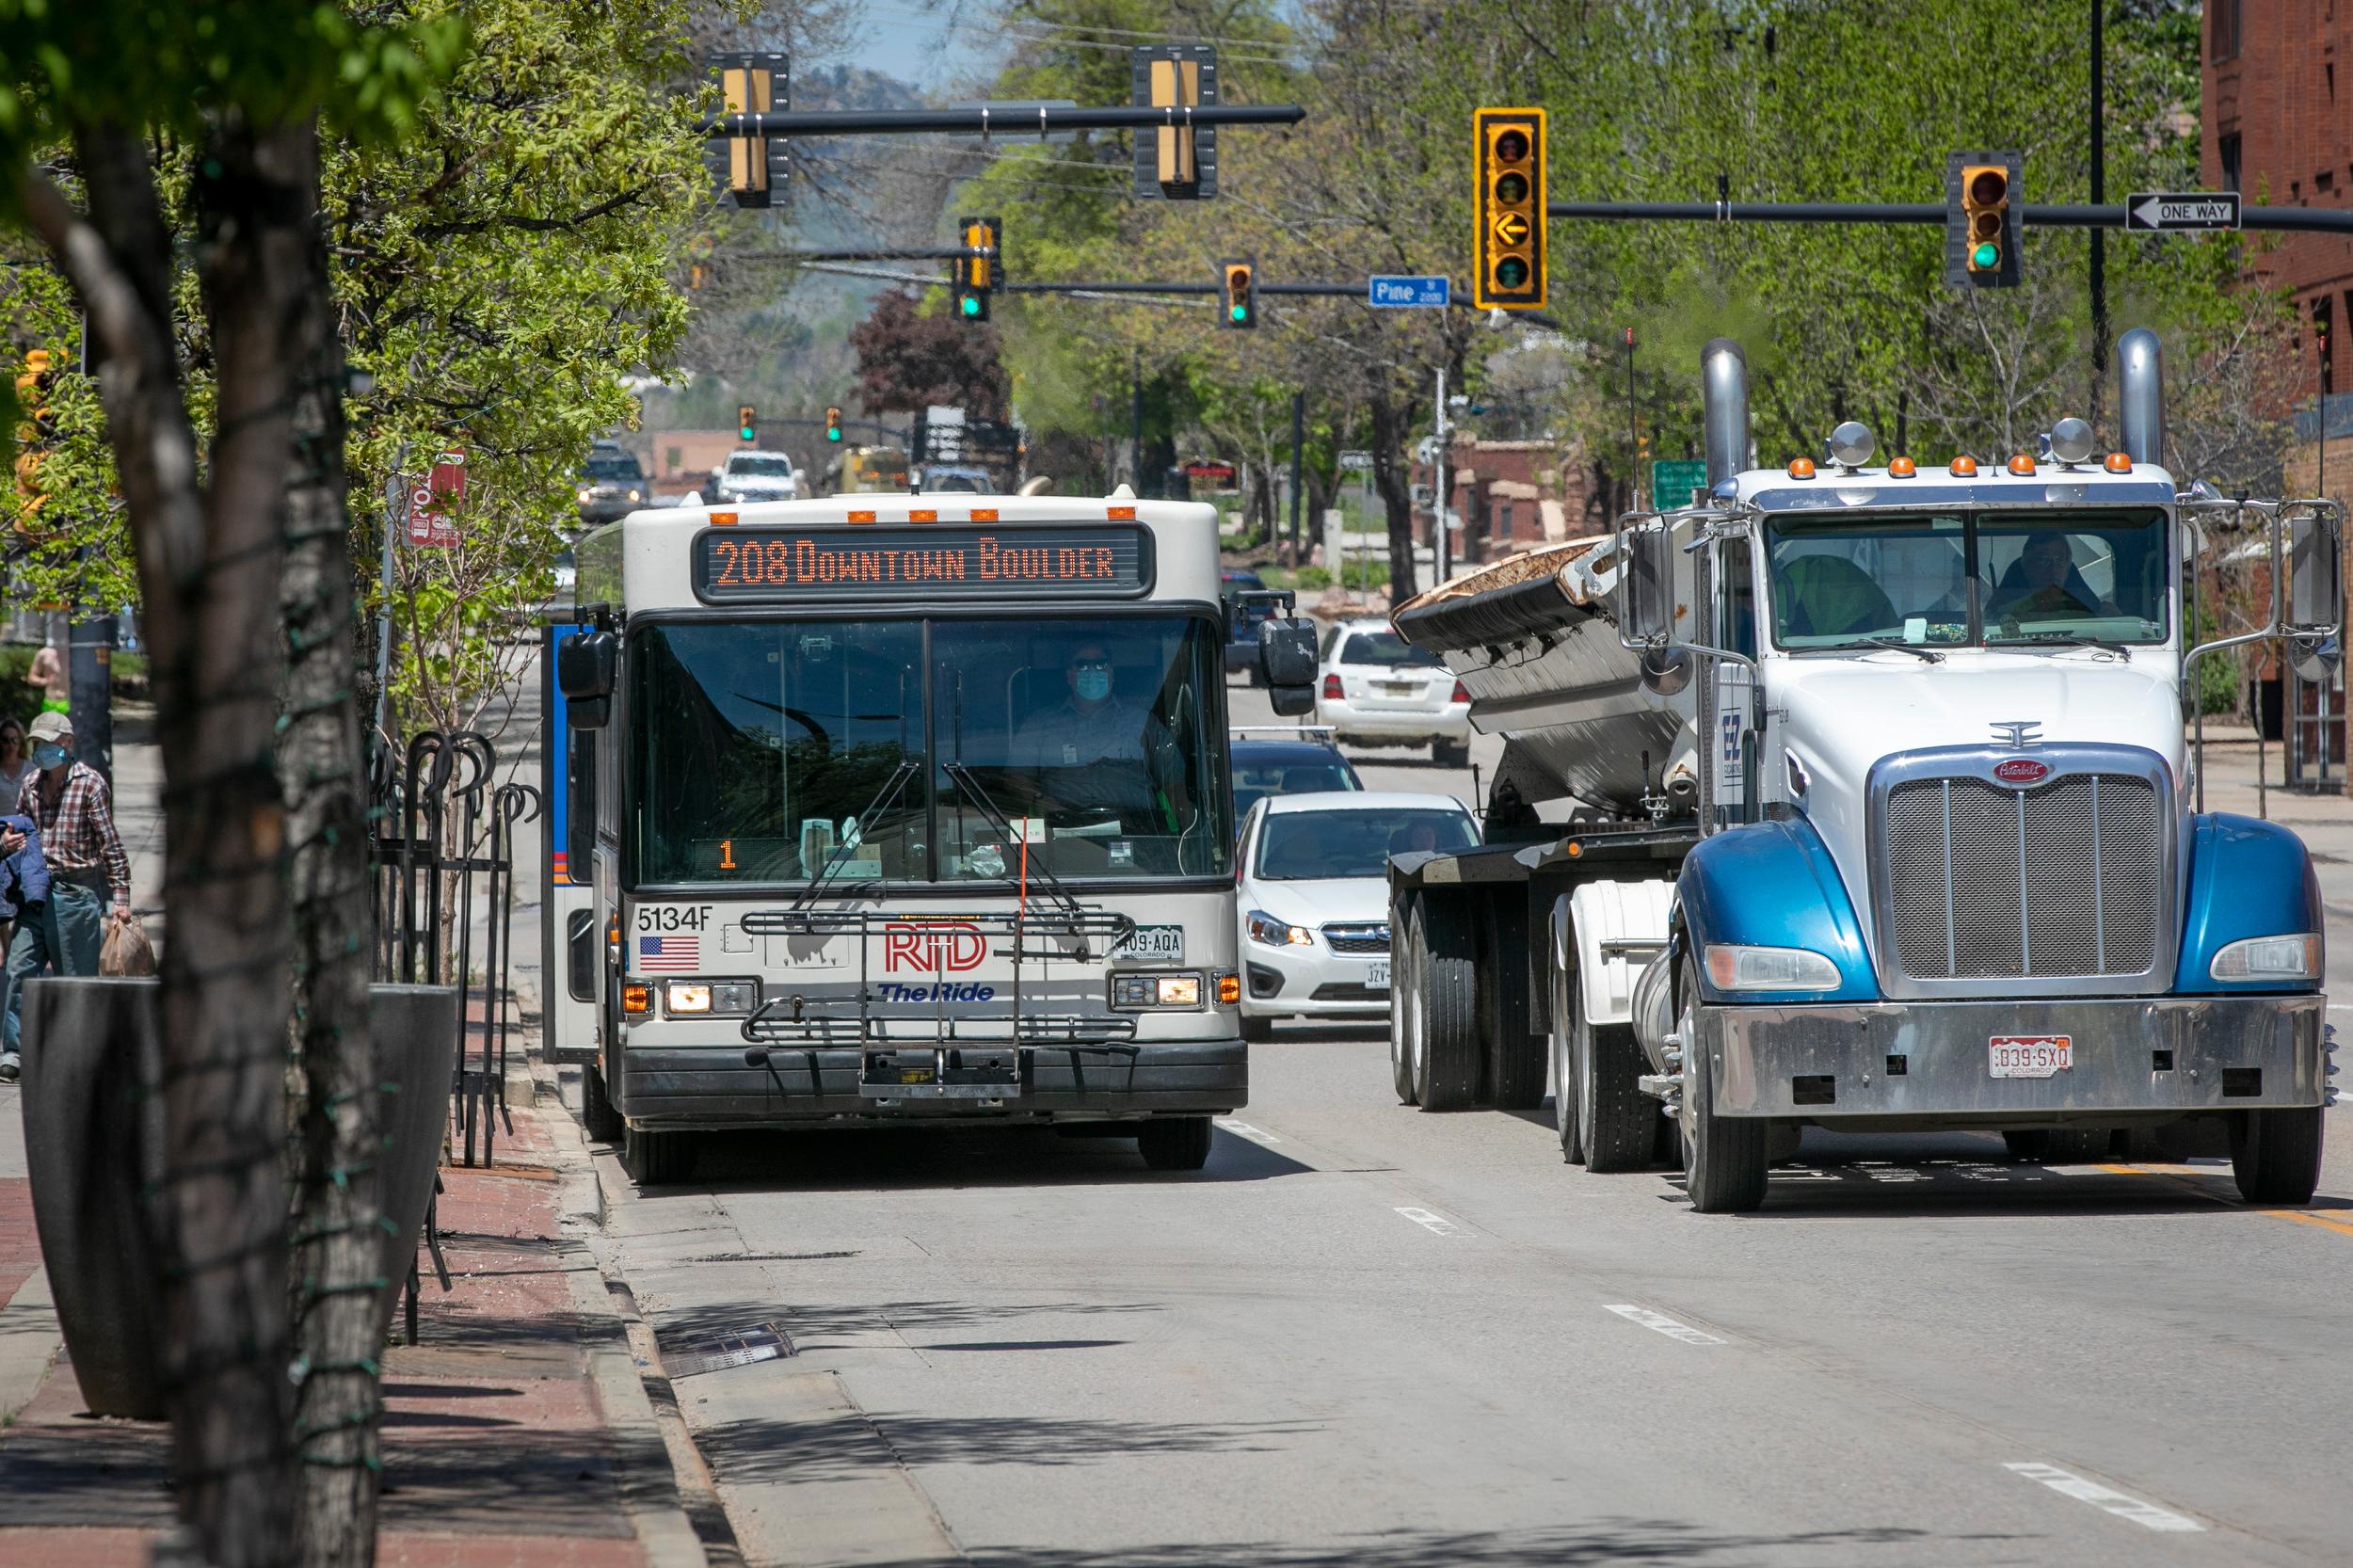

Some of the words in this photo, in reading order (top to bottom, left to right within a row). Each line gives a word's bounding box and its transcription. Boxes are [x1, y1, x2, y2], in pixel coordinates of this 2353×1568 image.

[2161, 205, 2191, 219] ONE
[2196, 205, 2228, 219] WAY
[1377, 282, 1415, 302] Pine
[715, 539, 789, 585] 208
[979, 536, 1113, 580] BOULDER
[1999, 763, 2042, 776] Peterbilt
[720, 840, 736, 869] 1
[638, 905, 712, 932] 5134F
[885, 922, 986, 972] RTD
[877, 984, 929, 1002] The
[930, 982, 995, 1001] Ride
